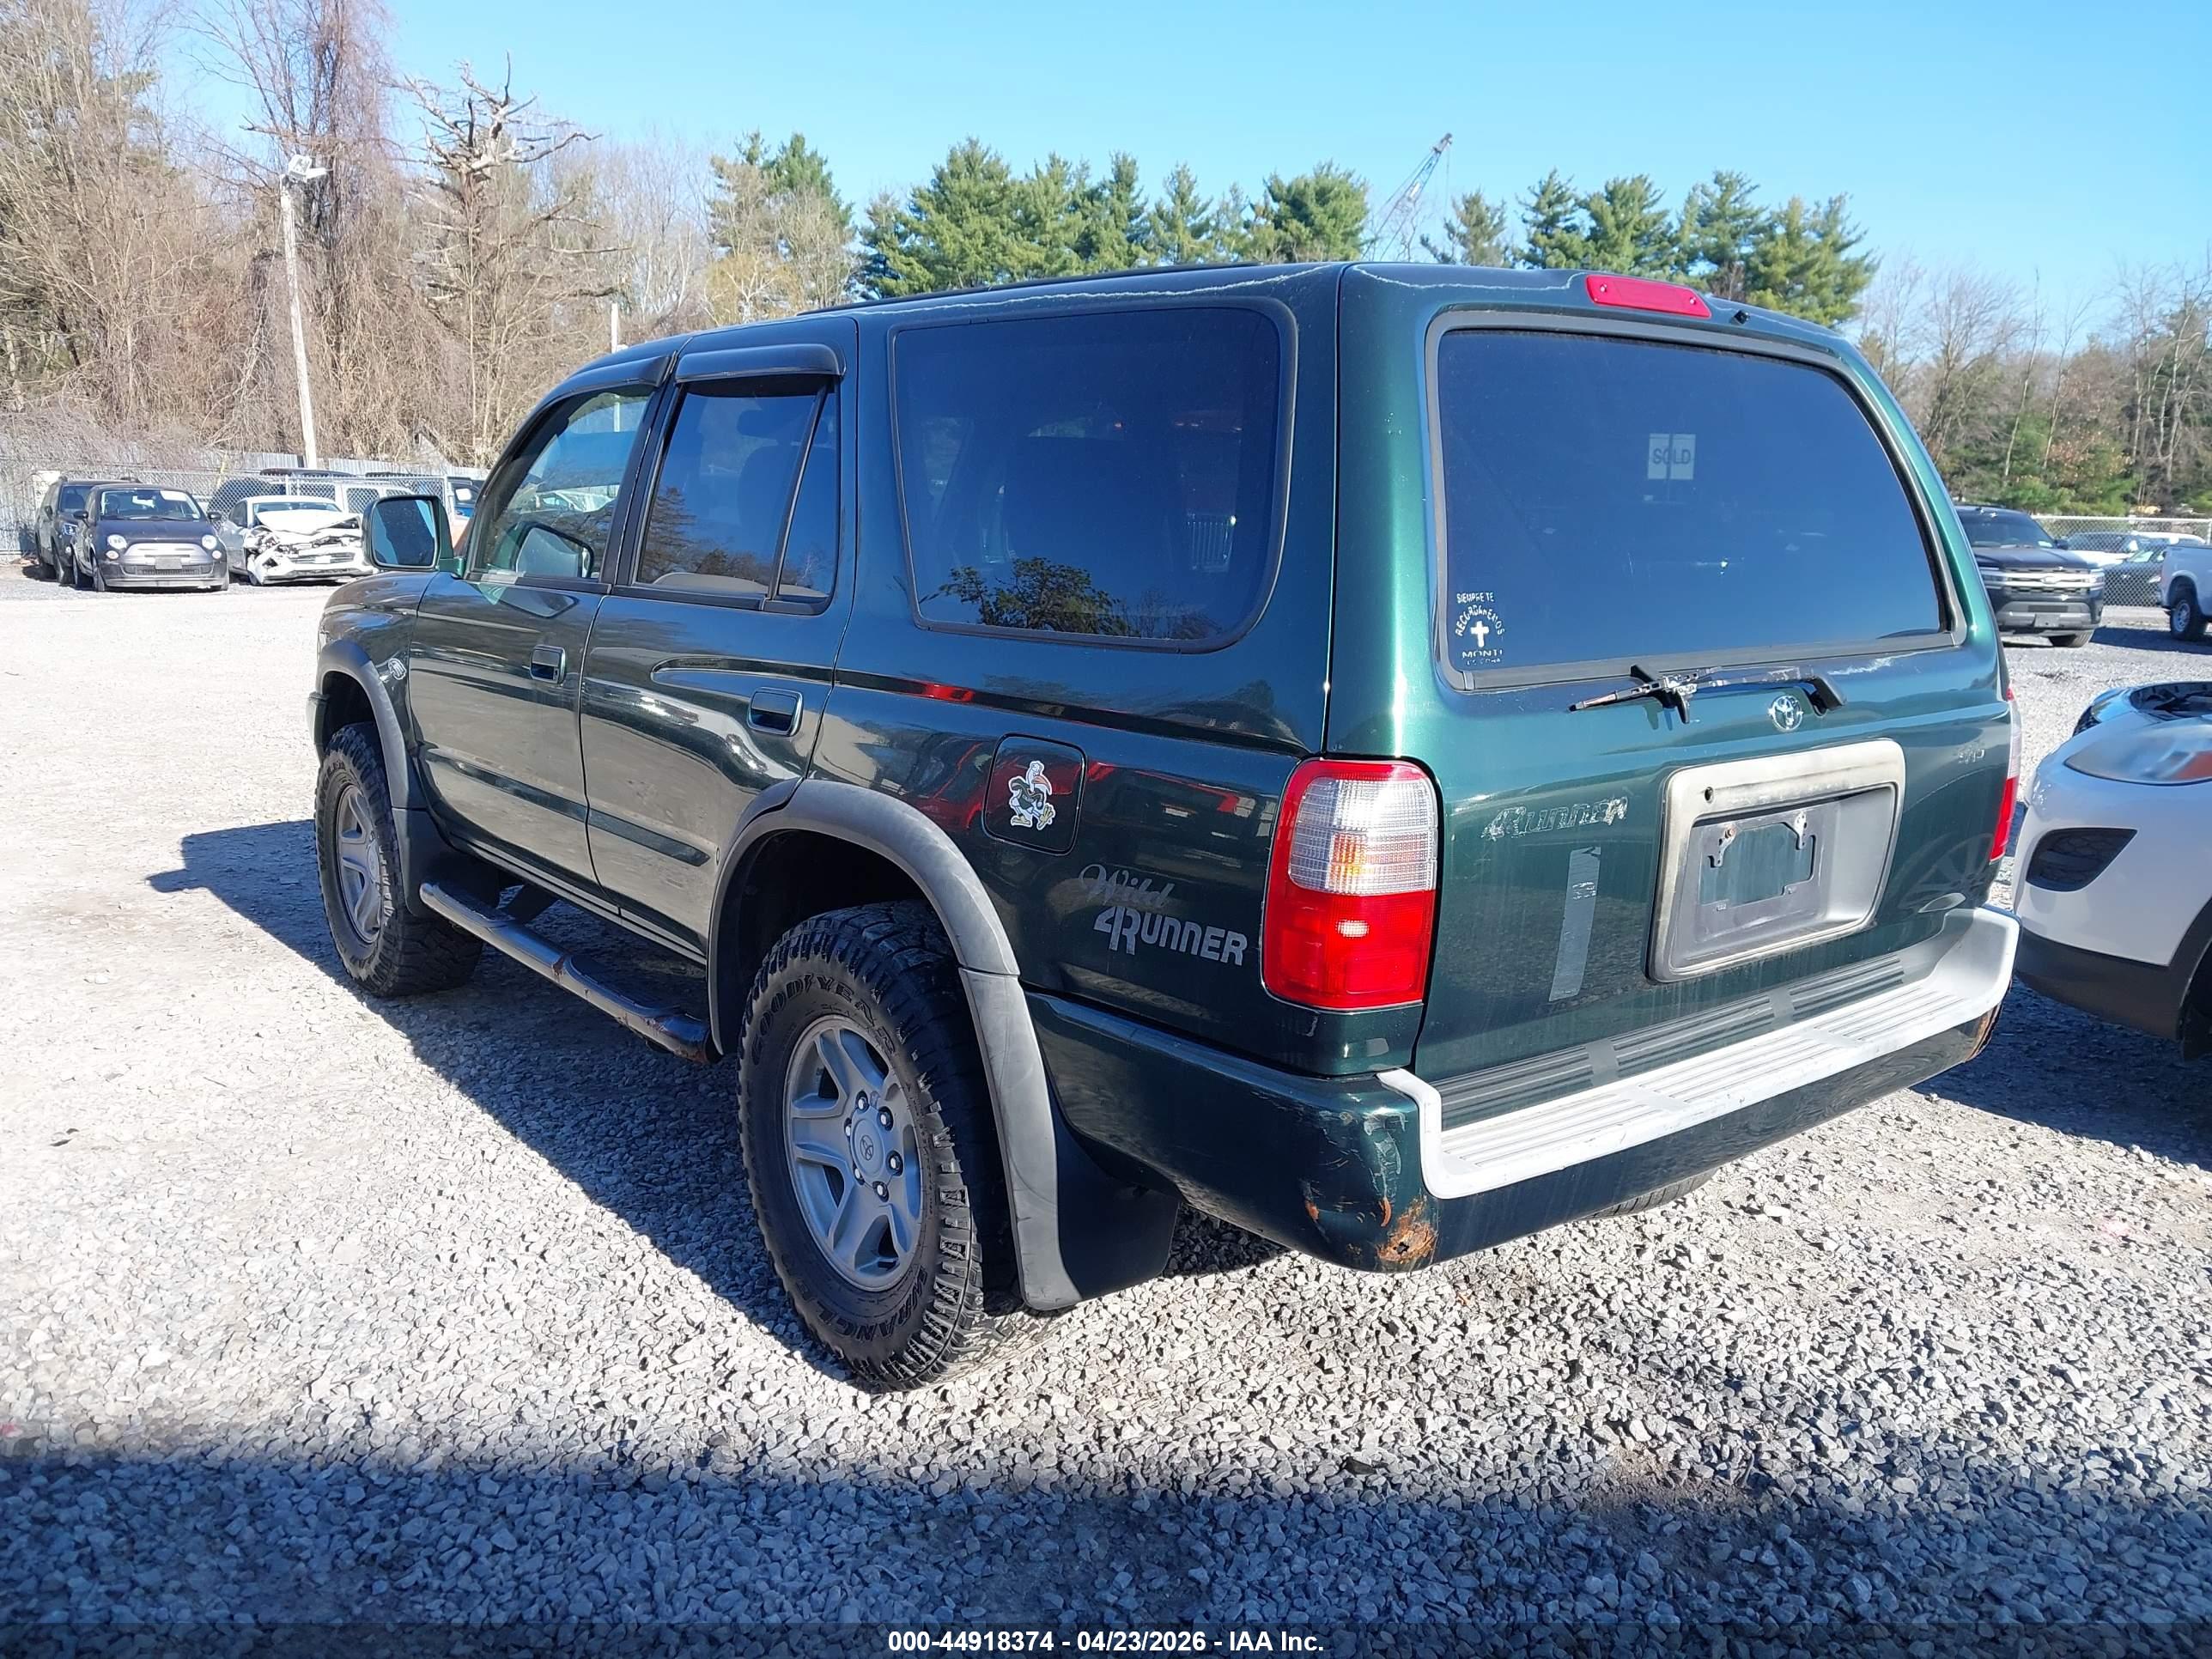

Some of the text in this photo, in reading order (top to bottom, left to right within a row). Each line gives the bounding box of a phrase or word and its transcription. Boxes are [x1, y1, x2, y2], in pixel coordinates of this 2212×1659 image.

[1652, 447, 1692, 465] SOLD
[1486, 592, 1495, 602] TE
[751, 973, 896, 1066] GOODYEAR
